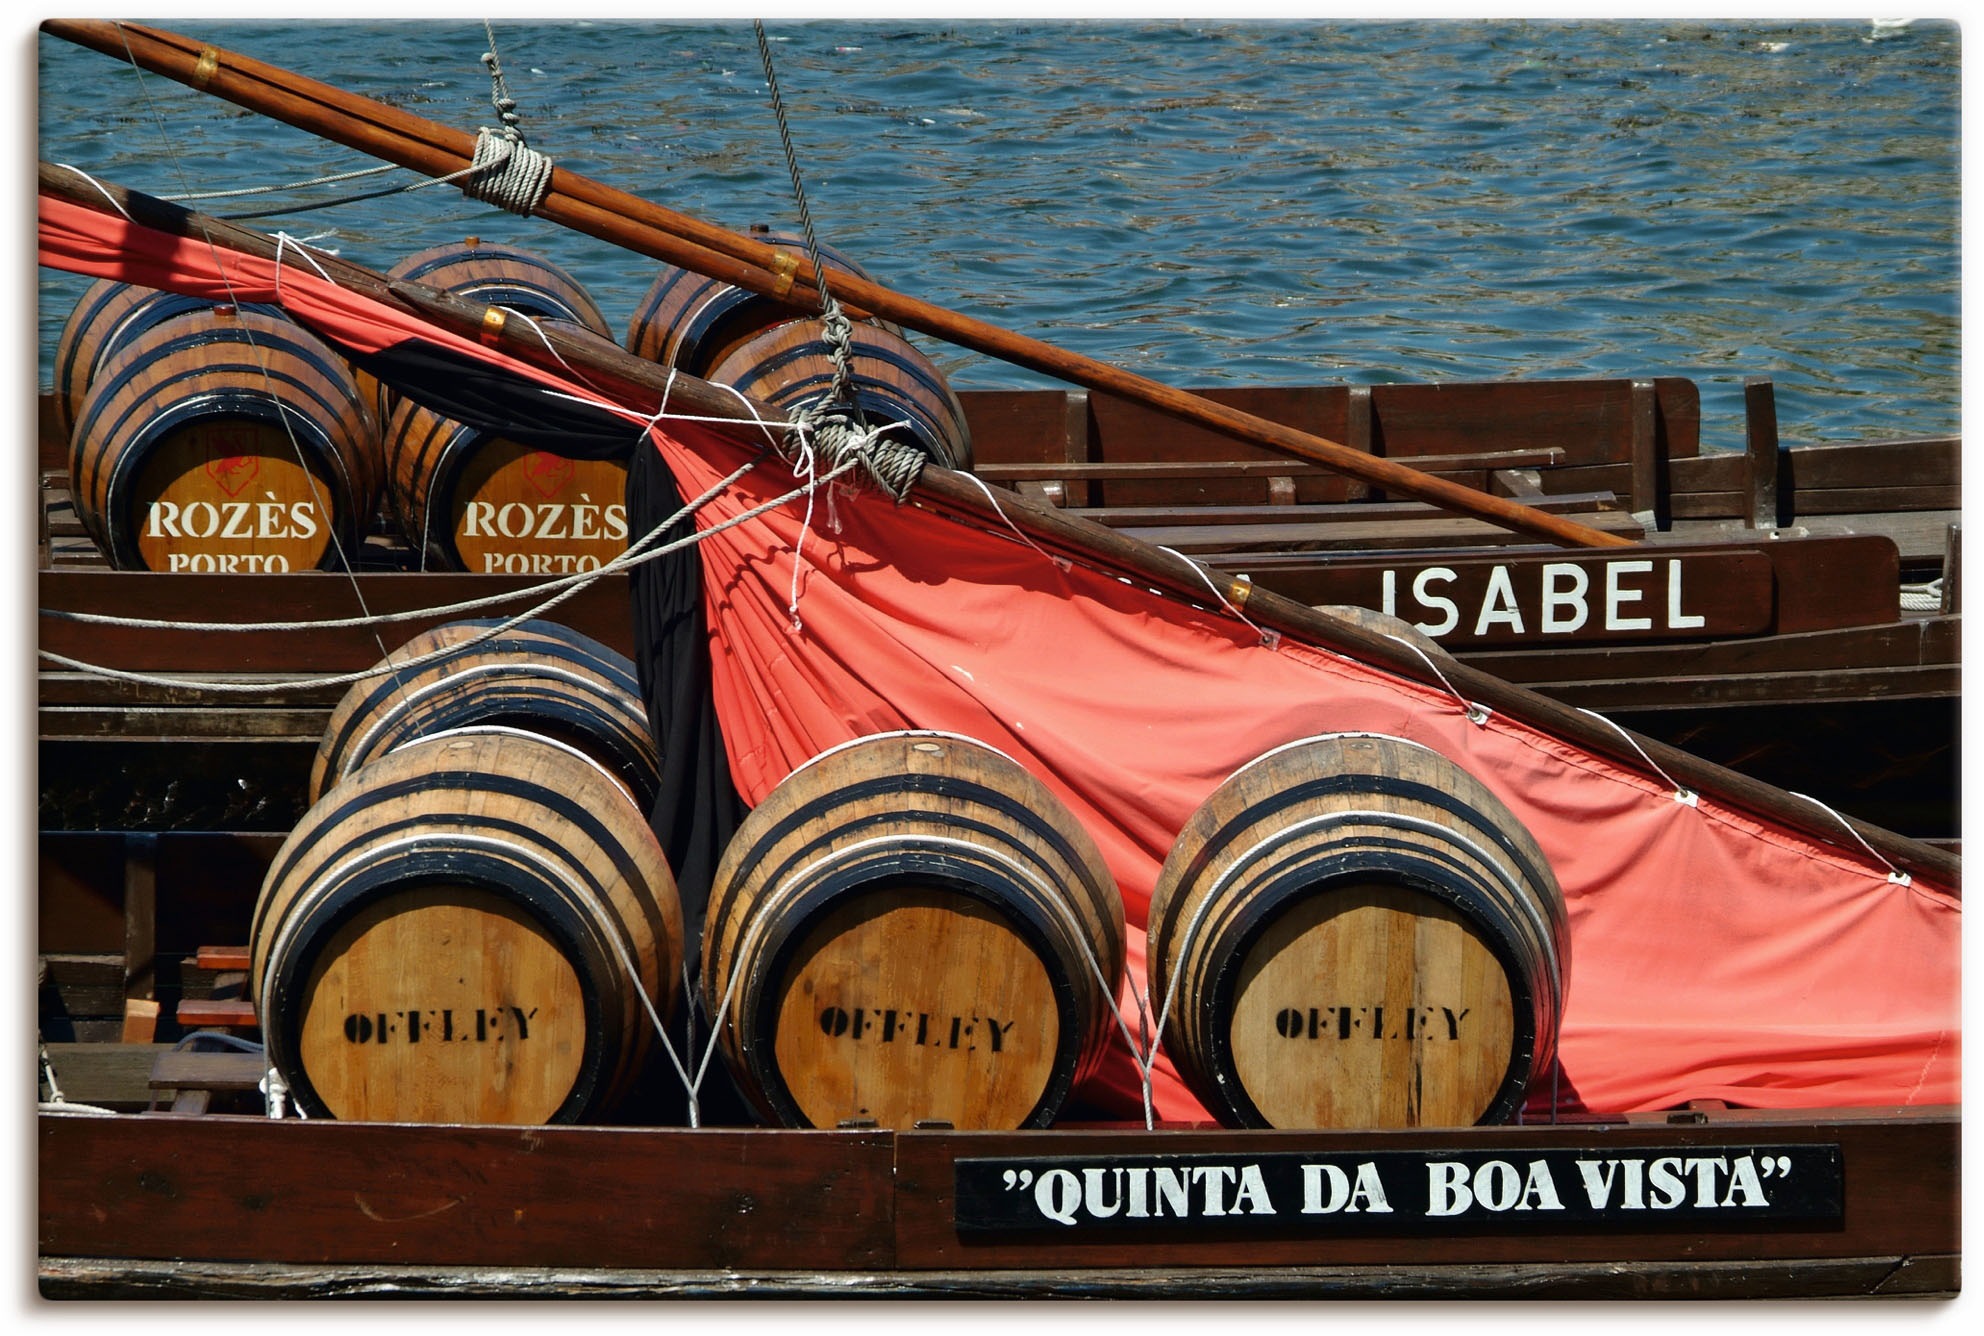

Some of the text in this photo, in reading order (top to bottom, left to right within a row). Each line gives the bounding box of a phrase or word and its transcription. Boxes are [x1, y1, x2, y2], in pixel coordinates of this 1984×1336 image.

[146, 490, 318, 540] ROZÈS
[462, 492, 629, 541] ROZÈS
[167, 553, 290, 573] PORTO
[483, 552, 601, 575] PORTO
[1382, 559, 1706, 638] ISABEL
[343, 1006, 539, 1045] OFFLEY
[819, 1006, 1015, 1054] OFFLEY
[1275, 1007, 1471, 1041] OFFLEY
[1300, 1161, 1394, 1214] DA
[1424, 1159, 1566, 1217] BOA
